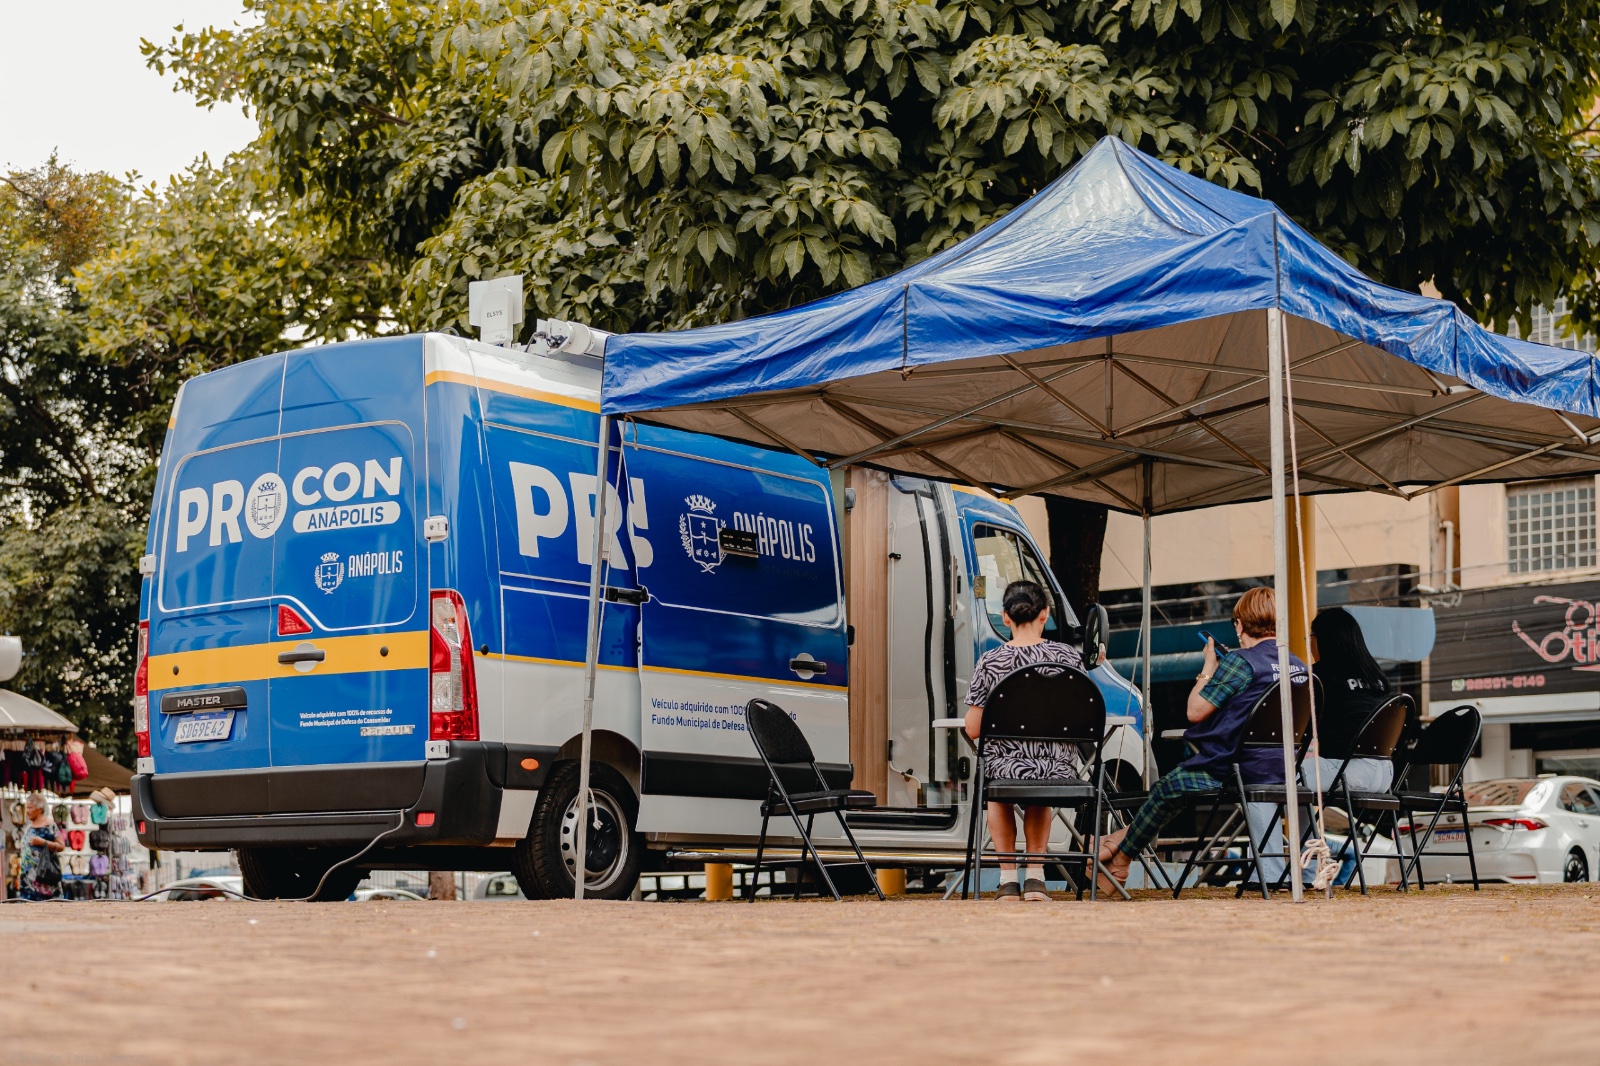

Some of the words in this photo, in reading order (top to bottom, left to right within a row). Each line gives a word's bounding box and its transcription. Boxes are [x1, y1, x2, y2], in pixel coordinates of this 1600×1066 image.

[486, 309, 503, 318] ELSYS
[307, 506, 384, 530] ANÁPOLIS
[348, 550, 403, 577] ANÁPOLIS
[177, 695, 221, 708] MASTER
[651, 698, 679, 711] Veículo
[680, 701, 713, 714] adquirido
[714, 705, 729, 714] com
[180, 720, 226, 739] SDG9E42
[314, 719, 335, 727] Municipal
[652, 714, 675, 726] Fundo
[676, 716, 711, 730] Municipal
[711, 718, 720, 729] de
[722, 720, 745, 731] Defesa
